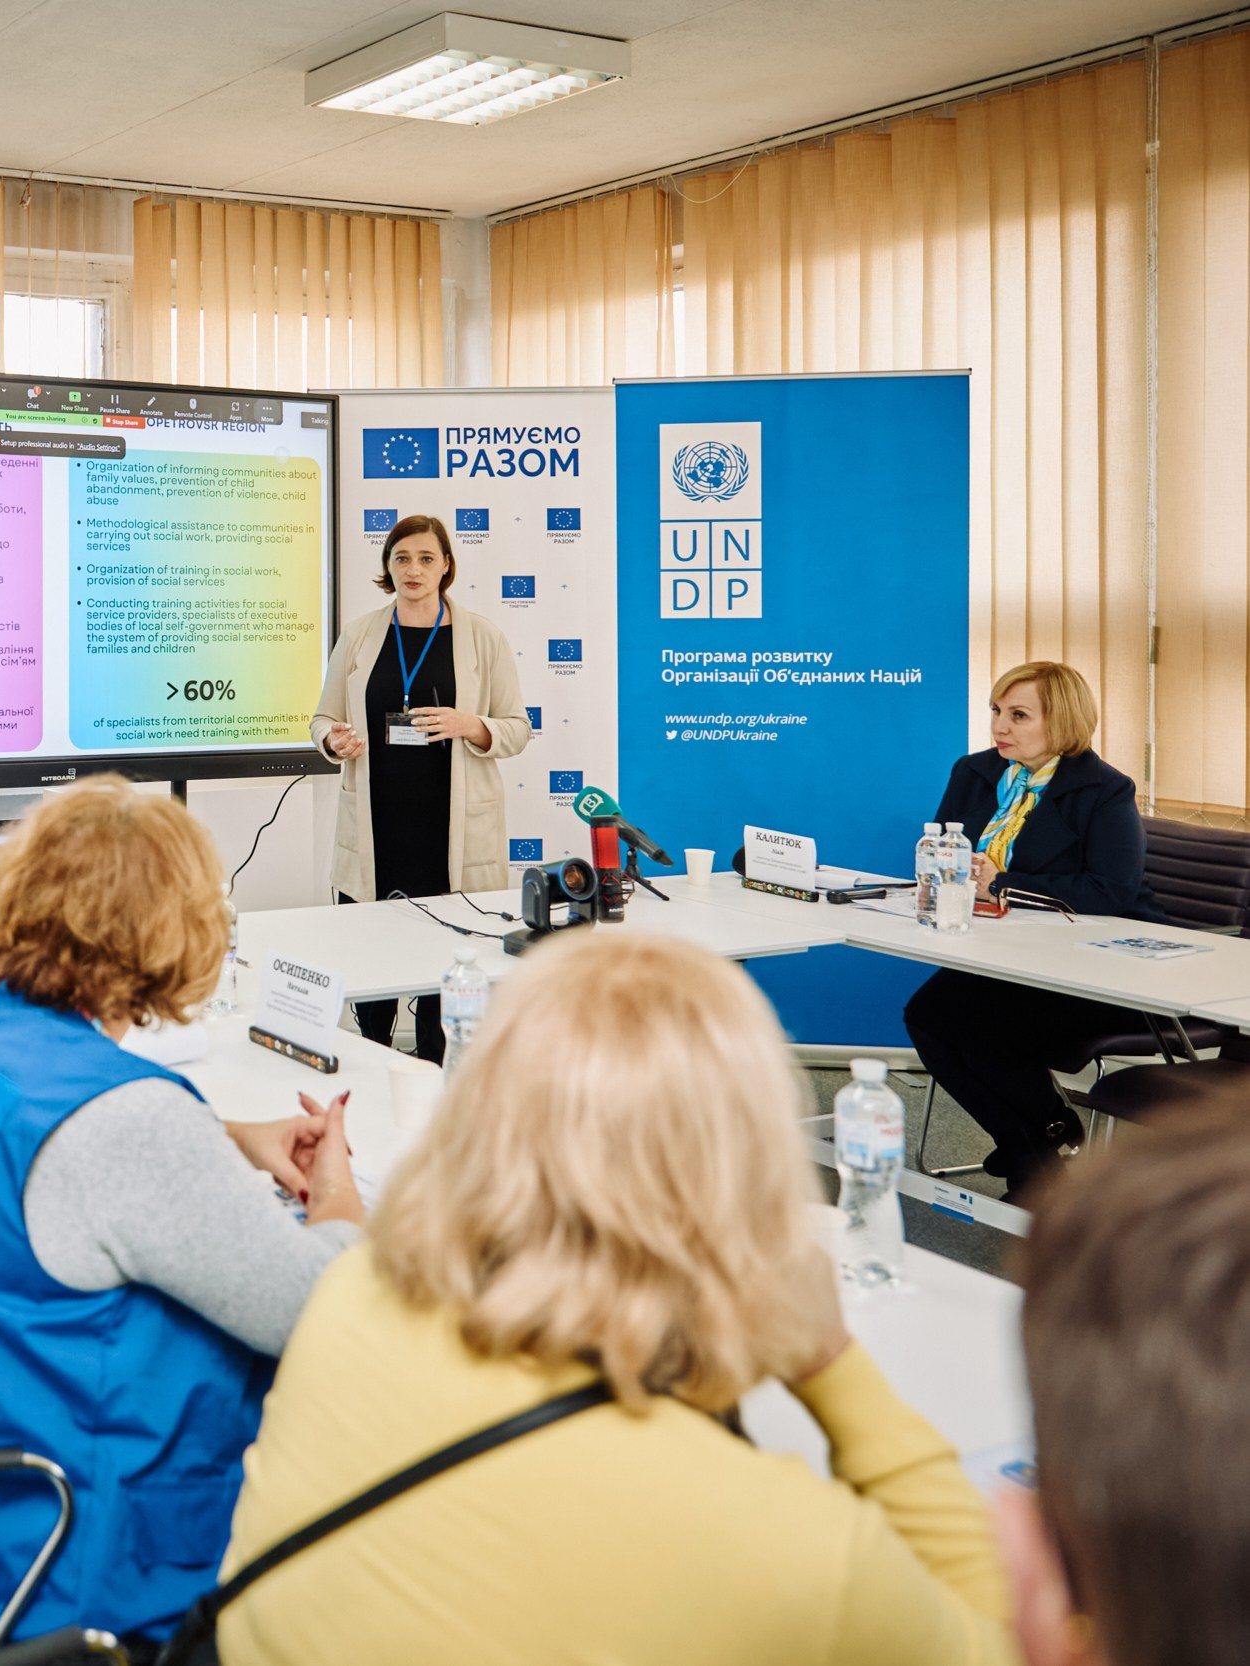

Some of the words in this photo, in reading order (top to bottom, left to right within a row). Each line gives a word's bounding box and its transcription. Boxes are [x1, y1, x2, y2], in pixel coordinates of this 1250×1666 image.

[222, 422, 266, 433] REGION
[446, 427, 580, 444] ПРЯМУЄМО
[0, 440, 16, 448] Setup
[18, 440, 51, 449] professional
[86, 461, 155, 476] Organization
[156, 463, 168, 474] of
[169, 464, 219, 479] informing
[221, 465, 286, 478] communities
[288, 468, 316, 479] about
[446, 448, 580, 478] РАЗОМ
[86, 518, 168, 533] Methodological
[170, 519, 225, 531] assistance
[226, 520, 238, 531] to
[239, 521, 303, 532] communities
[305, 522, 314, 533] in
[86, 564, 155, 578] Organization
[156, 564, 168, 575] of
[170, 565, 210, 578] training
[212, 565, 221, 576] in
[223, 565, 252, 576] social
[254, 565, 281, 579] work,
[86, 620, 122, 631] bodies
[124, 620, 136, 631] of
[138, 620, 163, 631] local
[165, 620, 250, 634] self-government
[252, 620, 273, 630] who
[275, 622, 314, 633] manage
[661, 650, 747, 666] Програма
[752, 651, 833, 666] розвитку
[661, 669, 759, 685] Організації
[870, 669, 922, 685] Націй
[665, 713, 807, 727] www.undp.org/ukraine
[115, 728, 145, 740] social
[147, 728, 172, 739] work
[174, 727, 200, 738] need
[201, 726, 239, 741] training
[240, 726, 262, 737] with
[264, 725, 288, 736] them
[681, 729, 778, 741] @UNDPUkraine
[756, 832, 802, 848] КАЛИТЮК
[273, 958, 330, 988] ОСИПЕНКО
